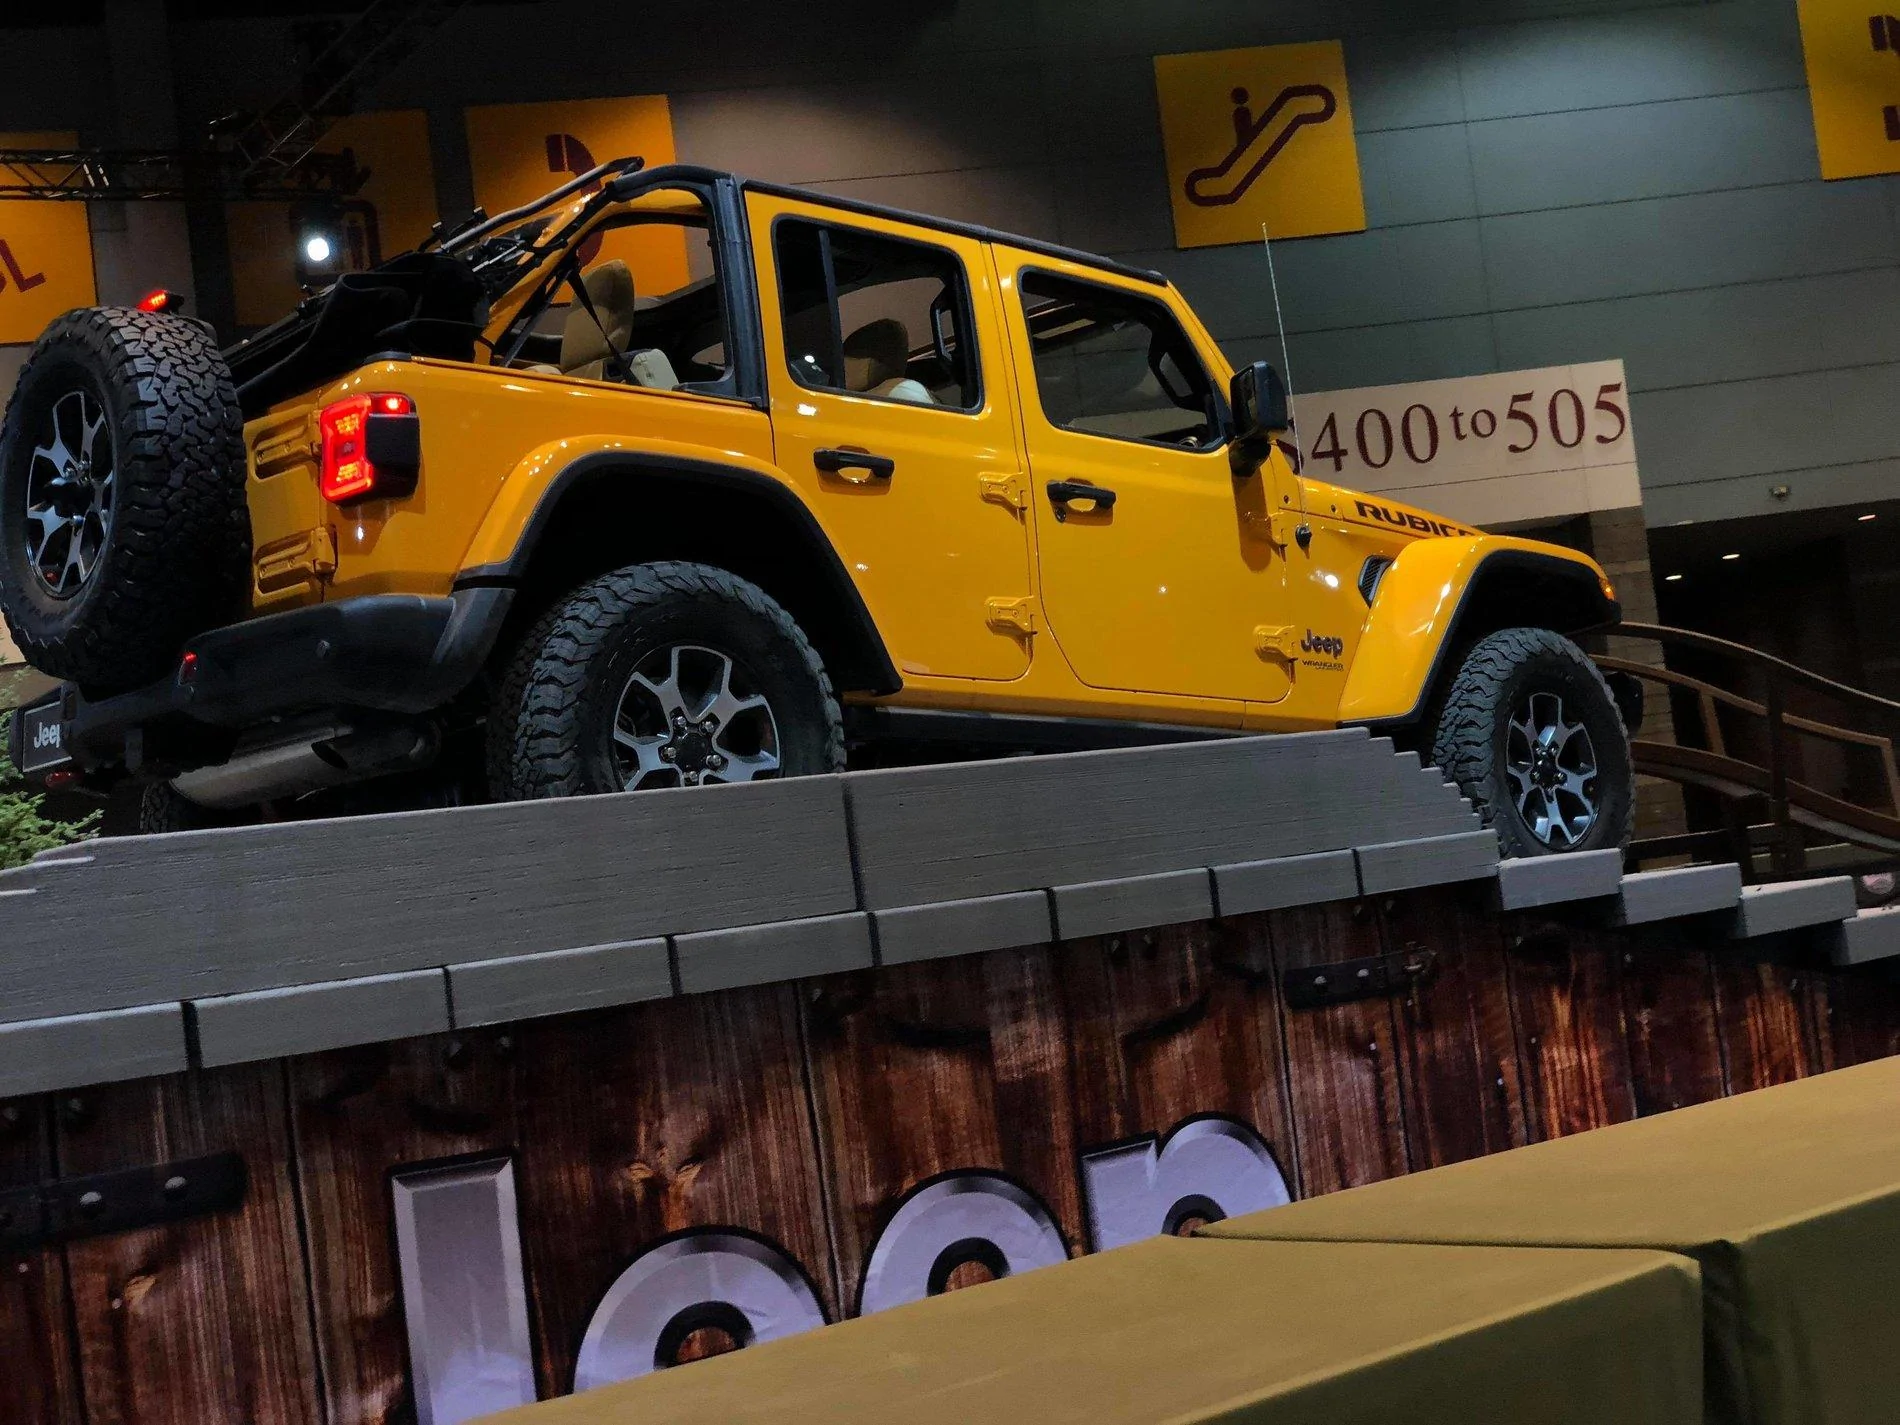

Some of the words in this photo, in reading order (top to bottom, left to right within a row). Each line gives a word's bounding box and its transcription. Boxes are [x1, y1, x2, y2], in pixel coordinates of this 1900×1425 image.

[1449, 406, 1497, 440] to
[1506, 382, 1626, 453] 505
[1354, 500, 1474, 537] RUBIC
[1300, 629, 1344, 660] Jeep
